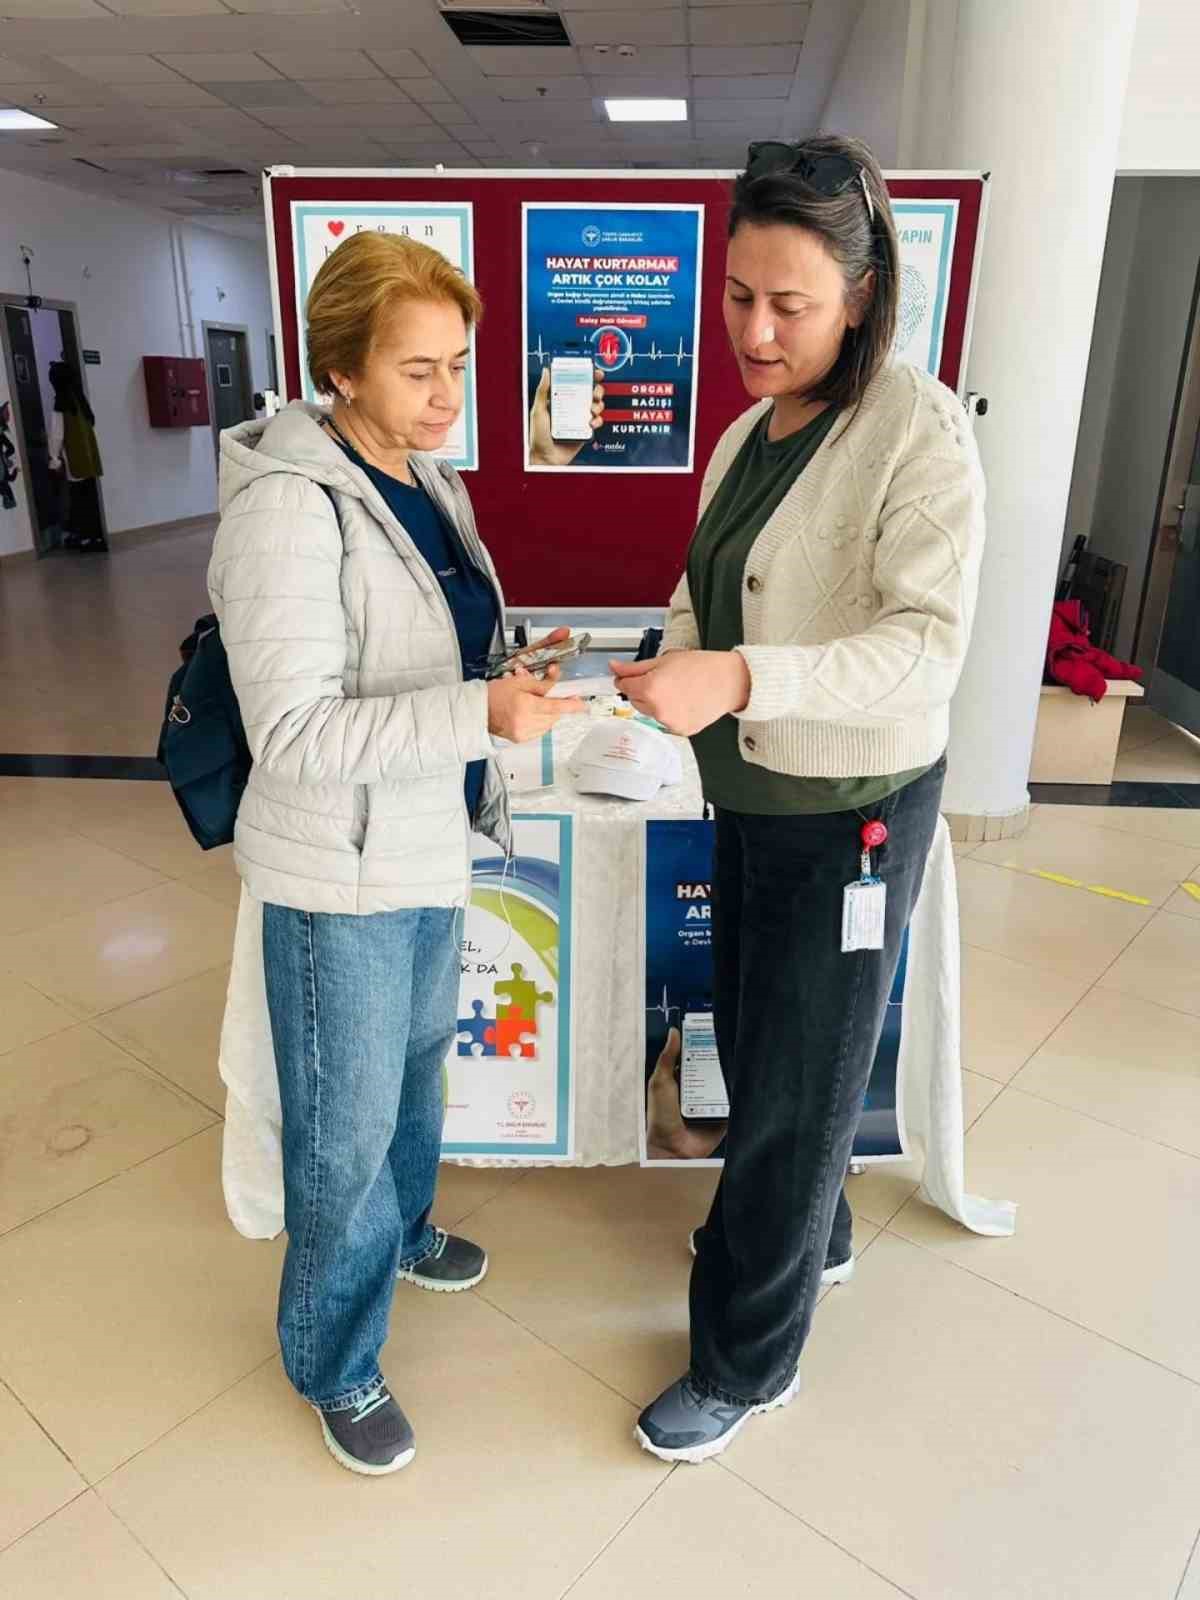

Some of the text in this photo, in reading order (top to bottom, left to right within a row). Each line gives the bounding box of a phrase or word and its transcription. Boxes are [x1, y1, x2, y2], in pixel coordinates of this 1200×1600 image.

[546, 257, 678, 271] HAYAT KURTARMAK
[552, 273, 671, 288] ARTIK ÇOK KOLAY
[632, 410, 672, 421] HAYAT
[477, 964, 499, 974] DA
